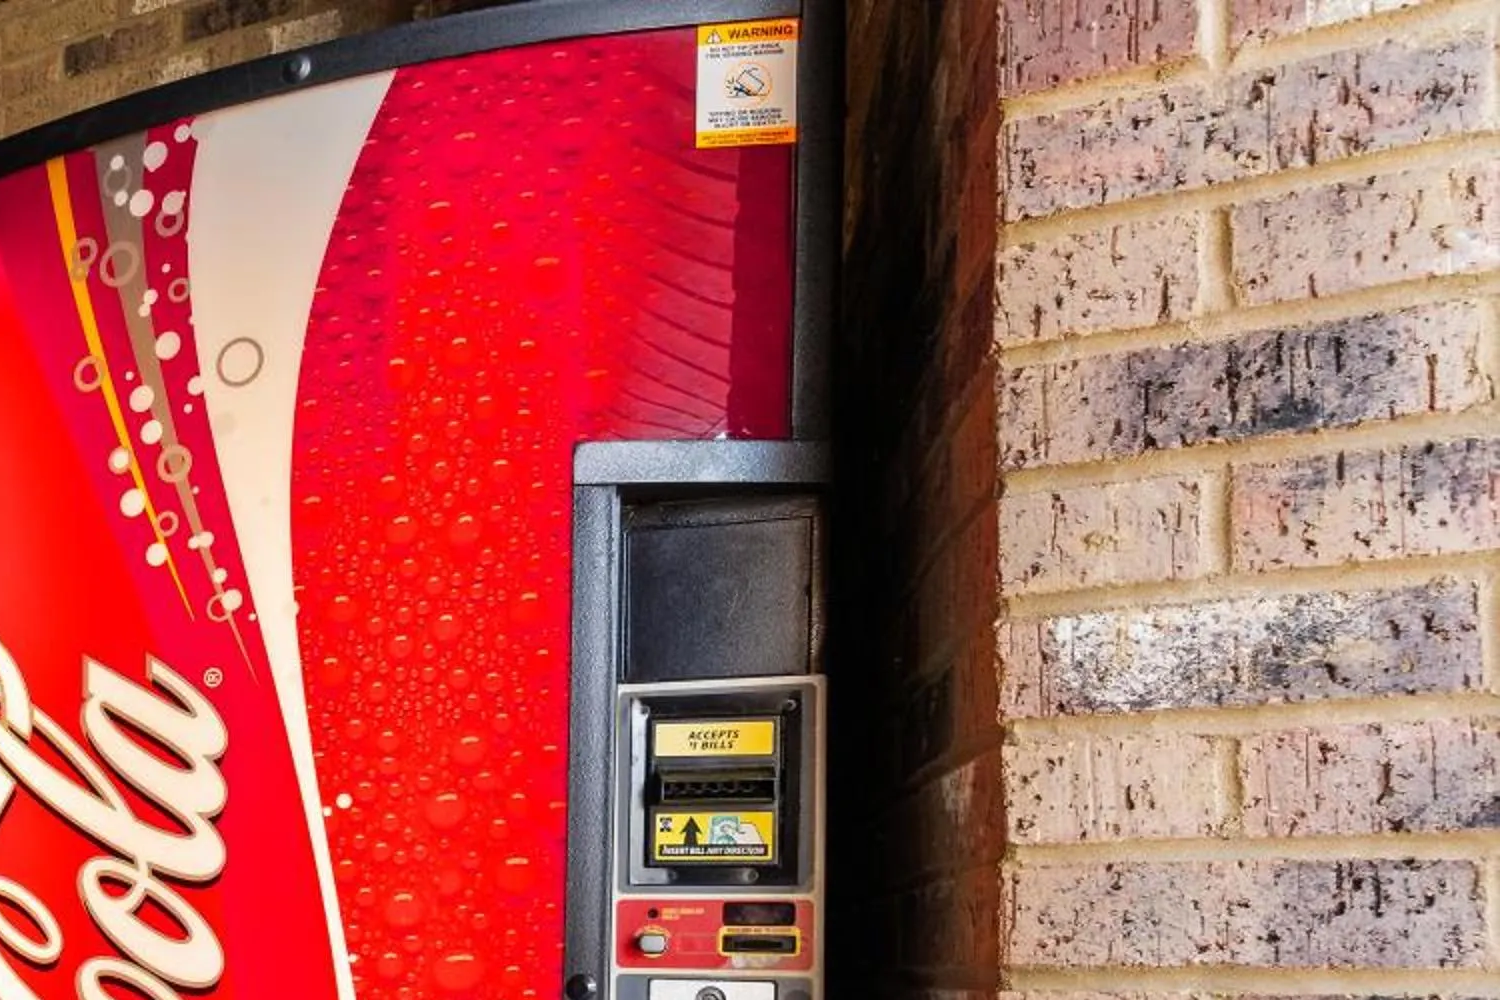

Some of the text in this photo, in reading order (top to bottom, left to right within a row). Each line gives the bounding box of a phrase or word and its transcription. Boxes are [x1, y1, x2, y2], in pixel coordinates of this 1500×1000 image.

[728, 24, 793, 39] WARNING
[689, 730, 740, 740] ACCEPTS
[701, 741, 734, 751] BILLS
